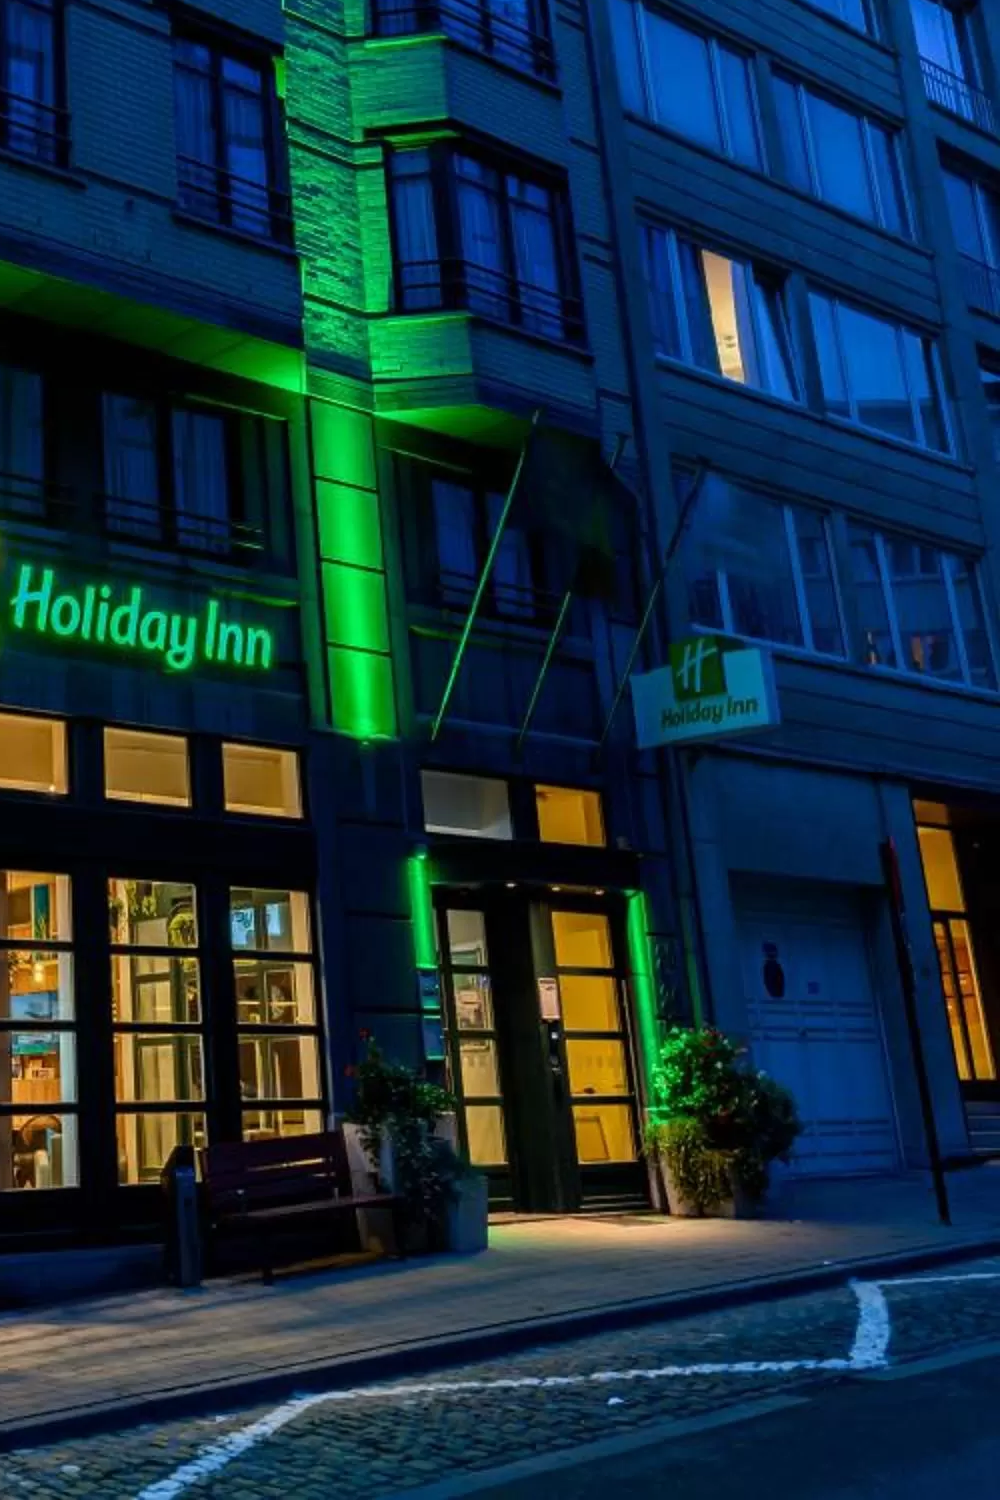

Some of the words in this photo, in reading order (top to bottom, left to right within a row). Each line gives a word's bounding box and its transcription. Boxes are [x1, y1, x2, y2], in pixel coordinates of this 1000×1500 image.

[11, 562, 198, 672] Holiday
[203, 598, 273, 670] Inn
[661, 700, 724, 726] Holiday
[727, 695, 759, 716] Inn
